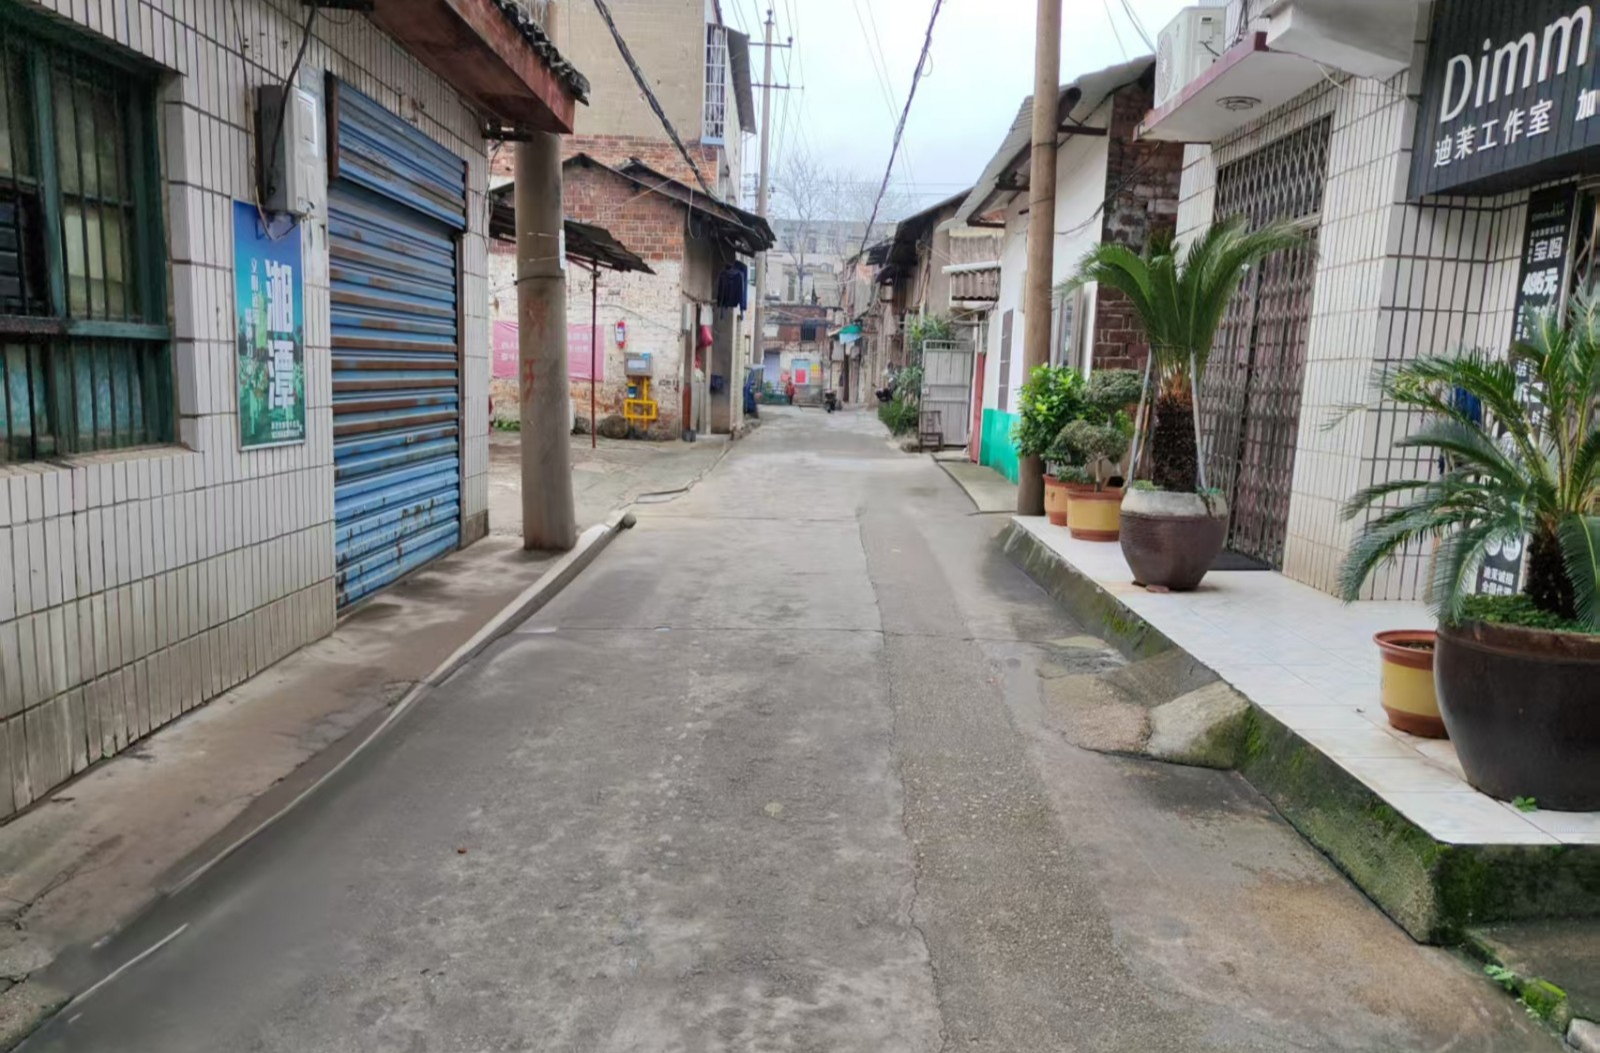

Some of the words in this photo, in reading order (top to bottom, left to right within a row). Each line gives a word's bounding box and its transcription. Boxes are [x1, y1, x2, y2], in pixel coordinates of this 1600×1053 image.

[1440, 5, 1592, 124] Dimm
[1533, 236, 1563, 262] 宝妈
[265, 259, 295, 410] 湘潭
